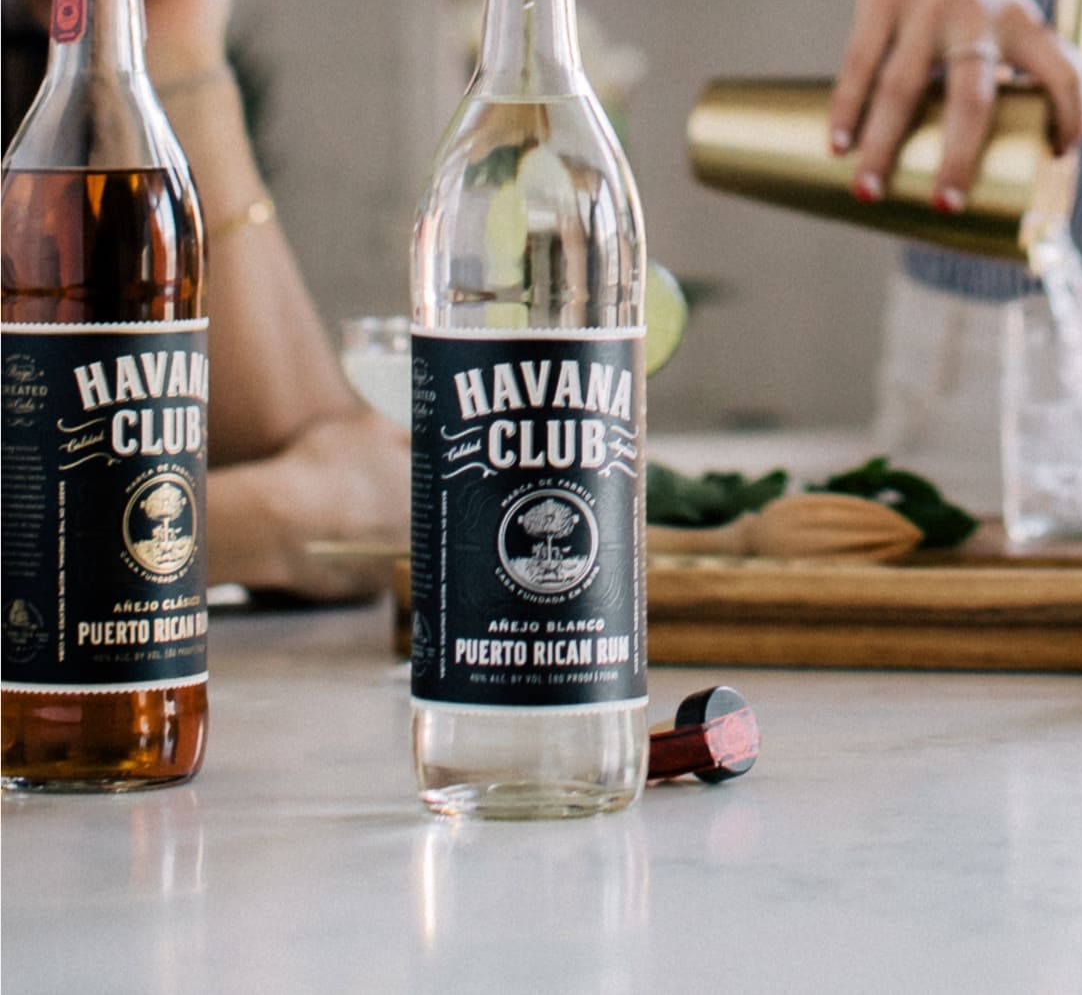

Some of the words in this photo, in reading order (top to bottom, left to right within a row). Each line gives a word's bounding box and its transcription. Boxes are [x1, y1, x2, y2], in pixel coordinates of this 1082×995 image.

[453, 360, 632, 421] HAVANA
[111, 406, 201, 456] CLUB
[488, 419, 607, 468] CLUB
[113, 599, 160, 614] AÑEJO
[78, 619, 150, 646] PUERTO
[154, 614, 194, 643] RICAN
[488, 618, 540, 633] AÑEJO
[545, 617, 605, 633] BLANCO
[455, 637, 527, 666] PUERTO
[533, 638, 592, 666] RICAN
[596, 635, 630, 664] RUM
